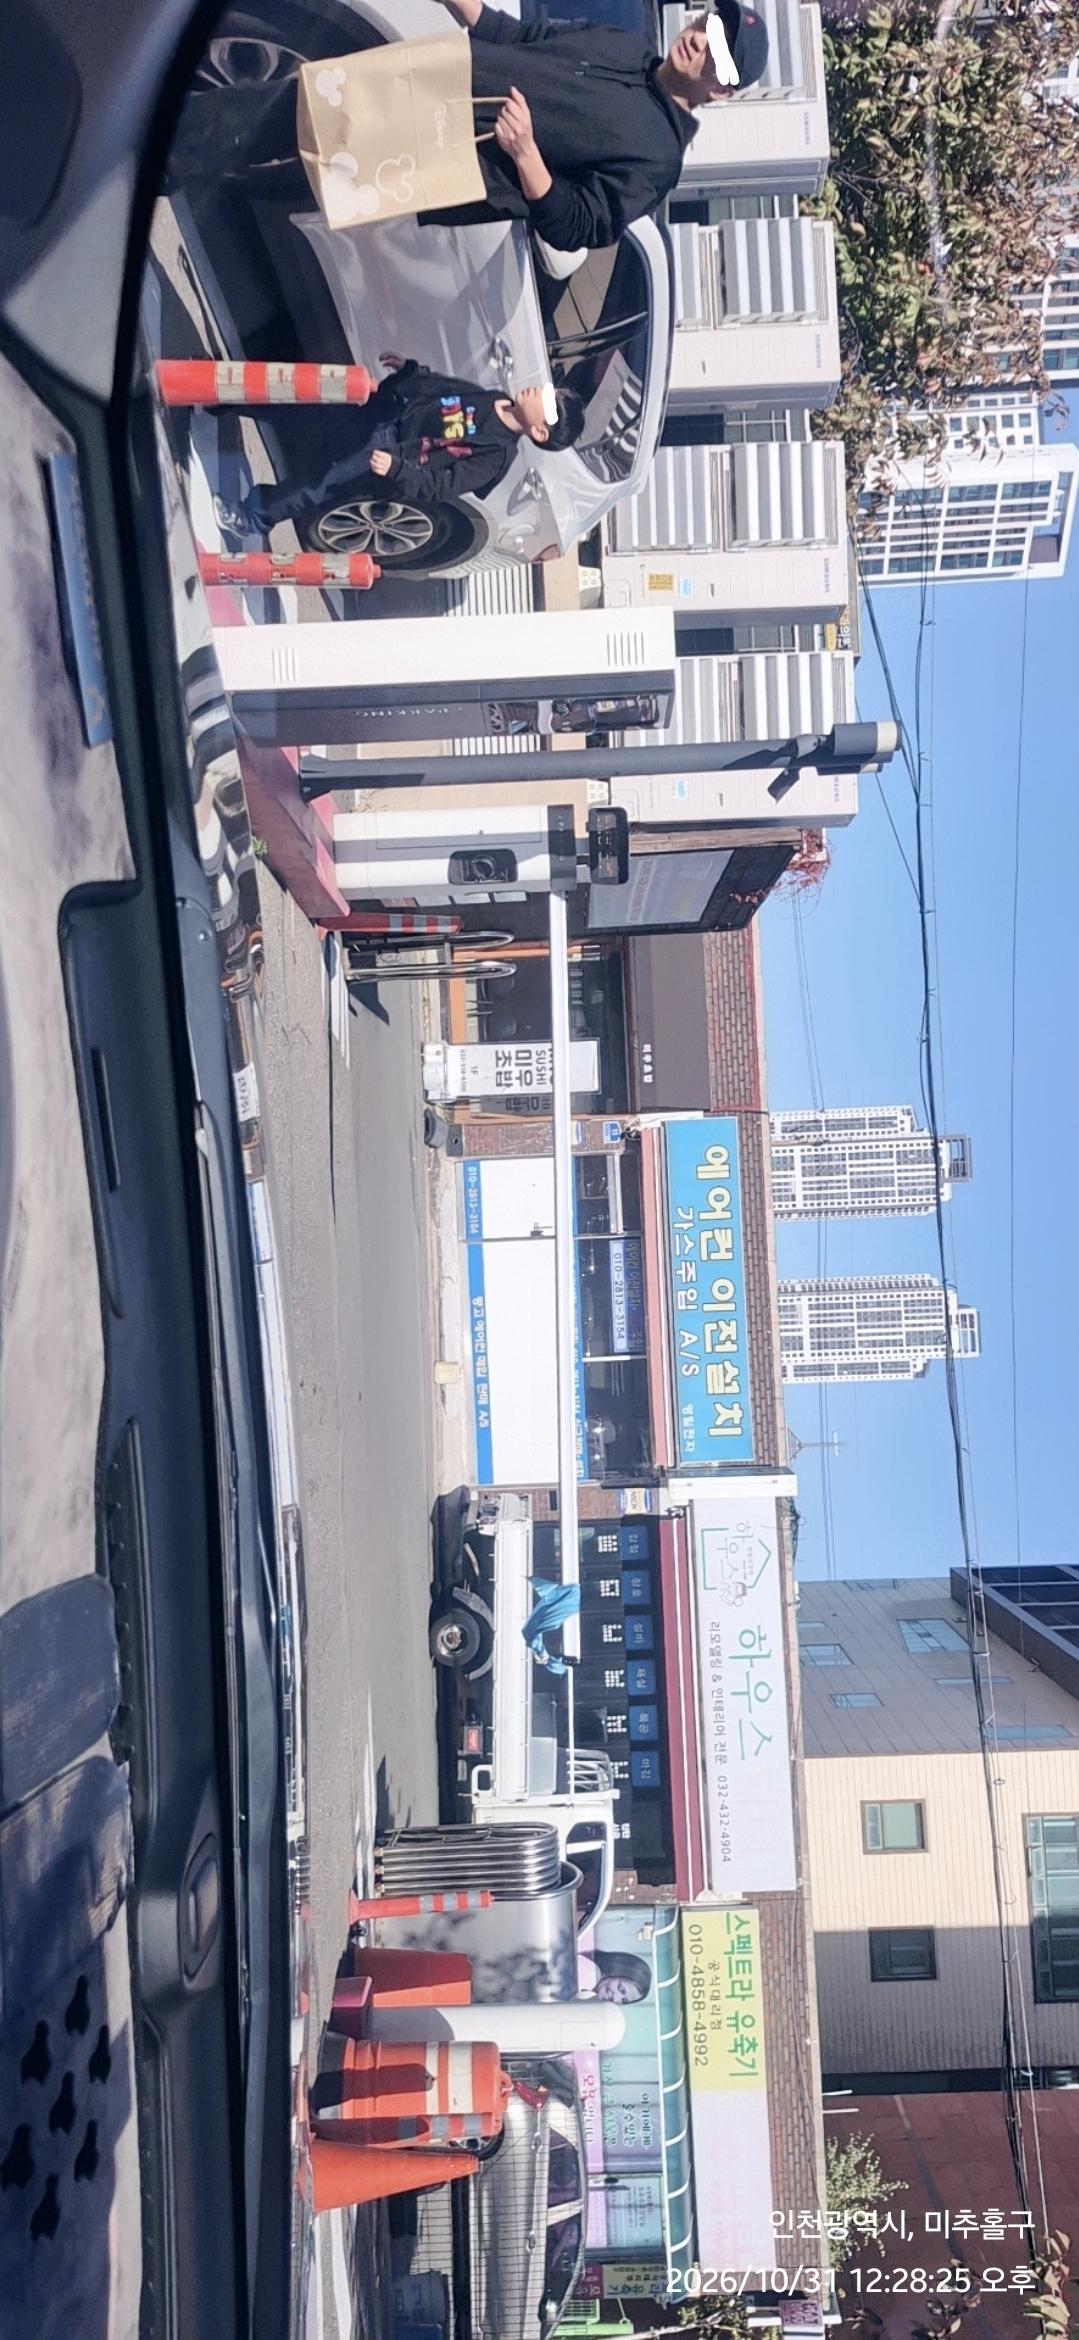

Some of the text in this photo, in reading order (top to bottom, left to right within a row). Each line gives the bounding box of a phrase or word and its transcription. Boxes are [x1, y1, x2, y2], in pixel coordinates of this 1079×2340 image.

[494, 1050, 514, 1088] 초밥
[514, 1050, 533, 1088] 미우
[536, 1050, 547, 1086] SUSHI
[613, 1253, 624, 1339] 010-2813-3154
[674, 1206, 700, 1376] 가스주입 A/S
[696, 1144, 743, 1437] 에어컨 이전설치
[478, 1410, 489, 1428] A/S
[729, 1624, 774, 1760] 하우스
[709, 1621, 732, 1863] 리모델링 & 인테리어 전문 032-432-4904
[688, 1924, 708, 2066] 010-4858-4992
[708, 1960, 722, 2030] 공식대리점
[724, 1912, 758, 2077] 스펙트라 유축기
[641, 2094, 652, 2146] 아기에게
